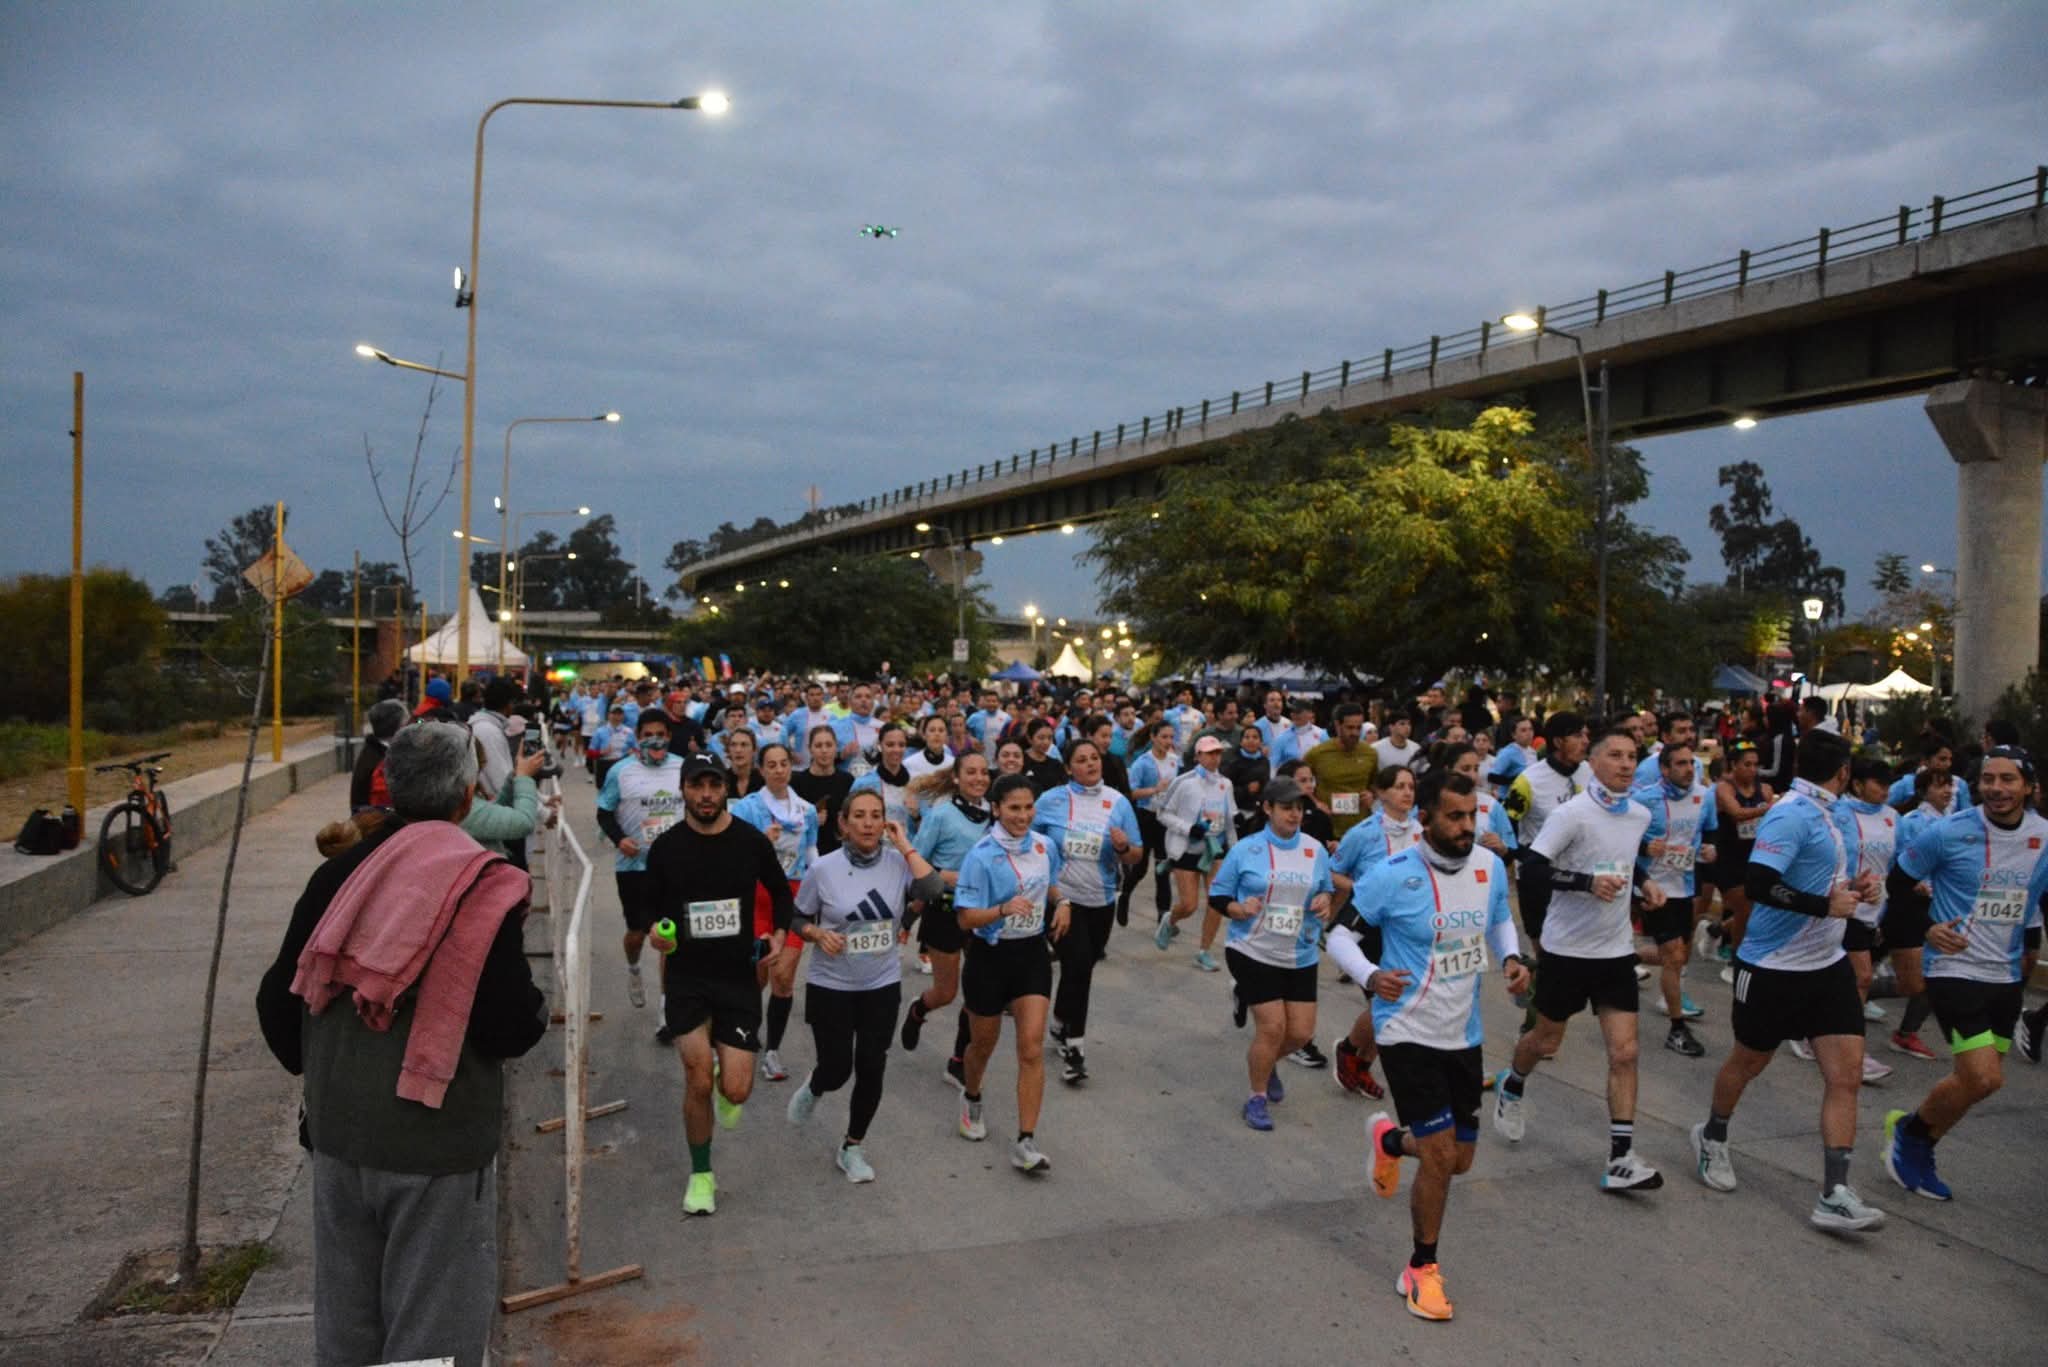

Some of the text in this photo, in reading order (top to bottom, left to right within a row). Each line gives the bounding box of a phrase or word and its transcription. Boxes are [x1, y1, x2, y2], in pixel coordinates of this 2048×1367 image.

[1980, 902, 2022, 918] 1042
[694, 914, 736, 931] 1894
[1268, 915, 1301, 931] 1347
[850, 932, 890, 950] 1878
[1439, 947, 1482, 974] 1173
